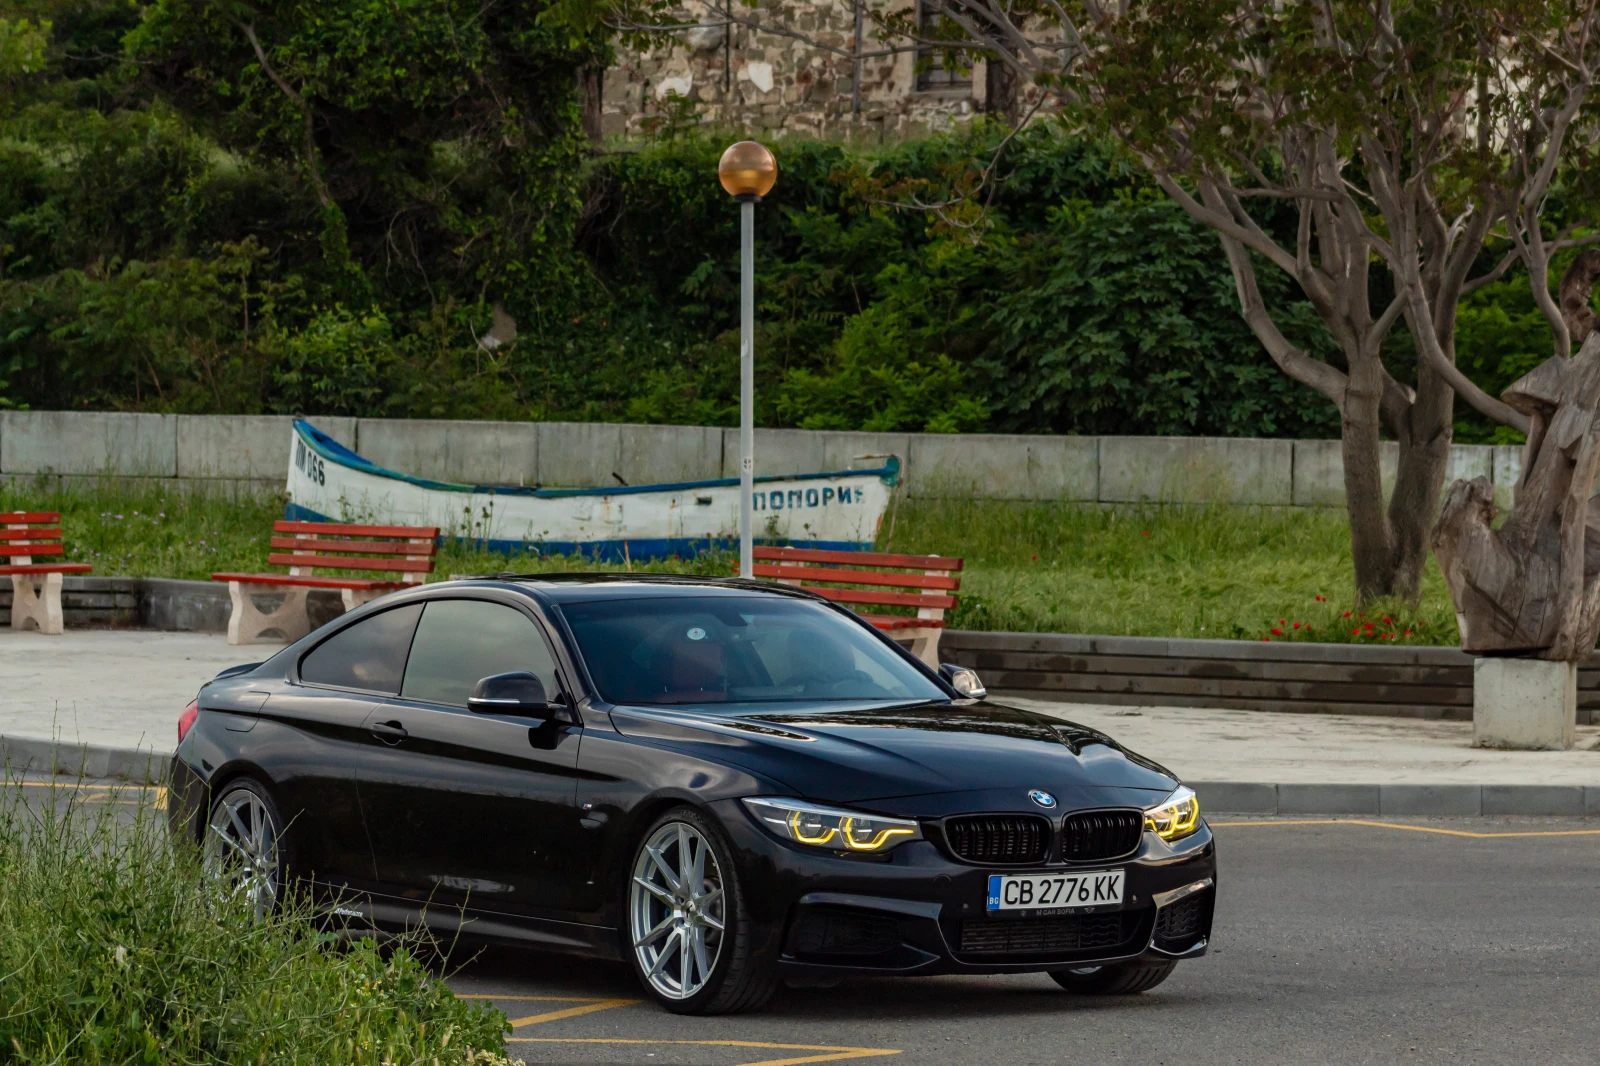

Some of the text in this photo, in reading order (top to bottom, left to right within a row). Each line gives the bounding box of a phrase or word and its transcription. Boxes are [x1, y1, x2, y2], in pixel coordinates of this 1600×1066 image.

[307, 450, 325, 487] 066
[989, 896, 999, 905] BG
[1004, 875, 1120, 905] CB 2776 KK
